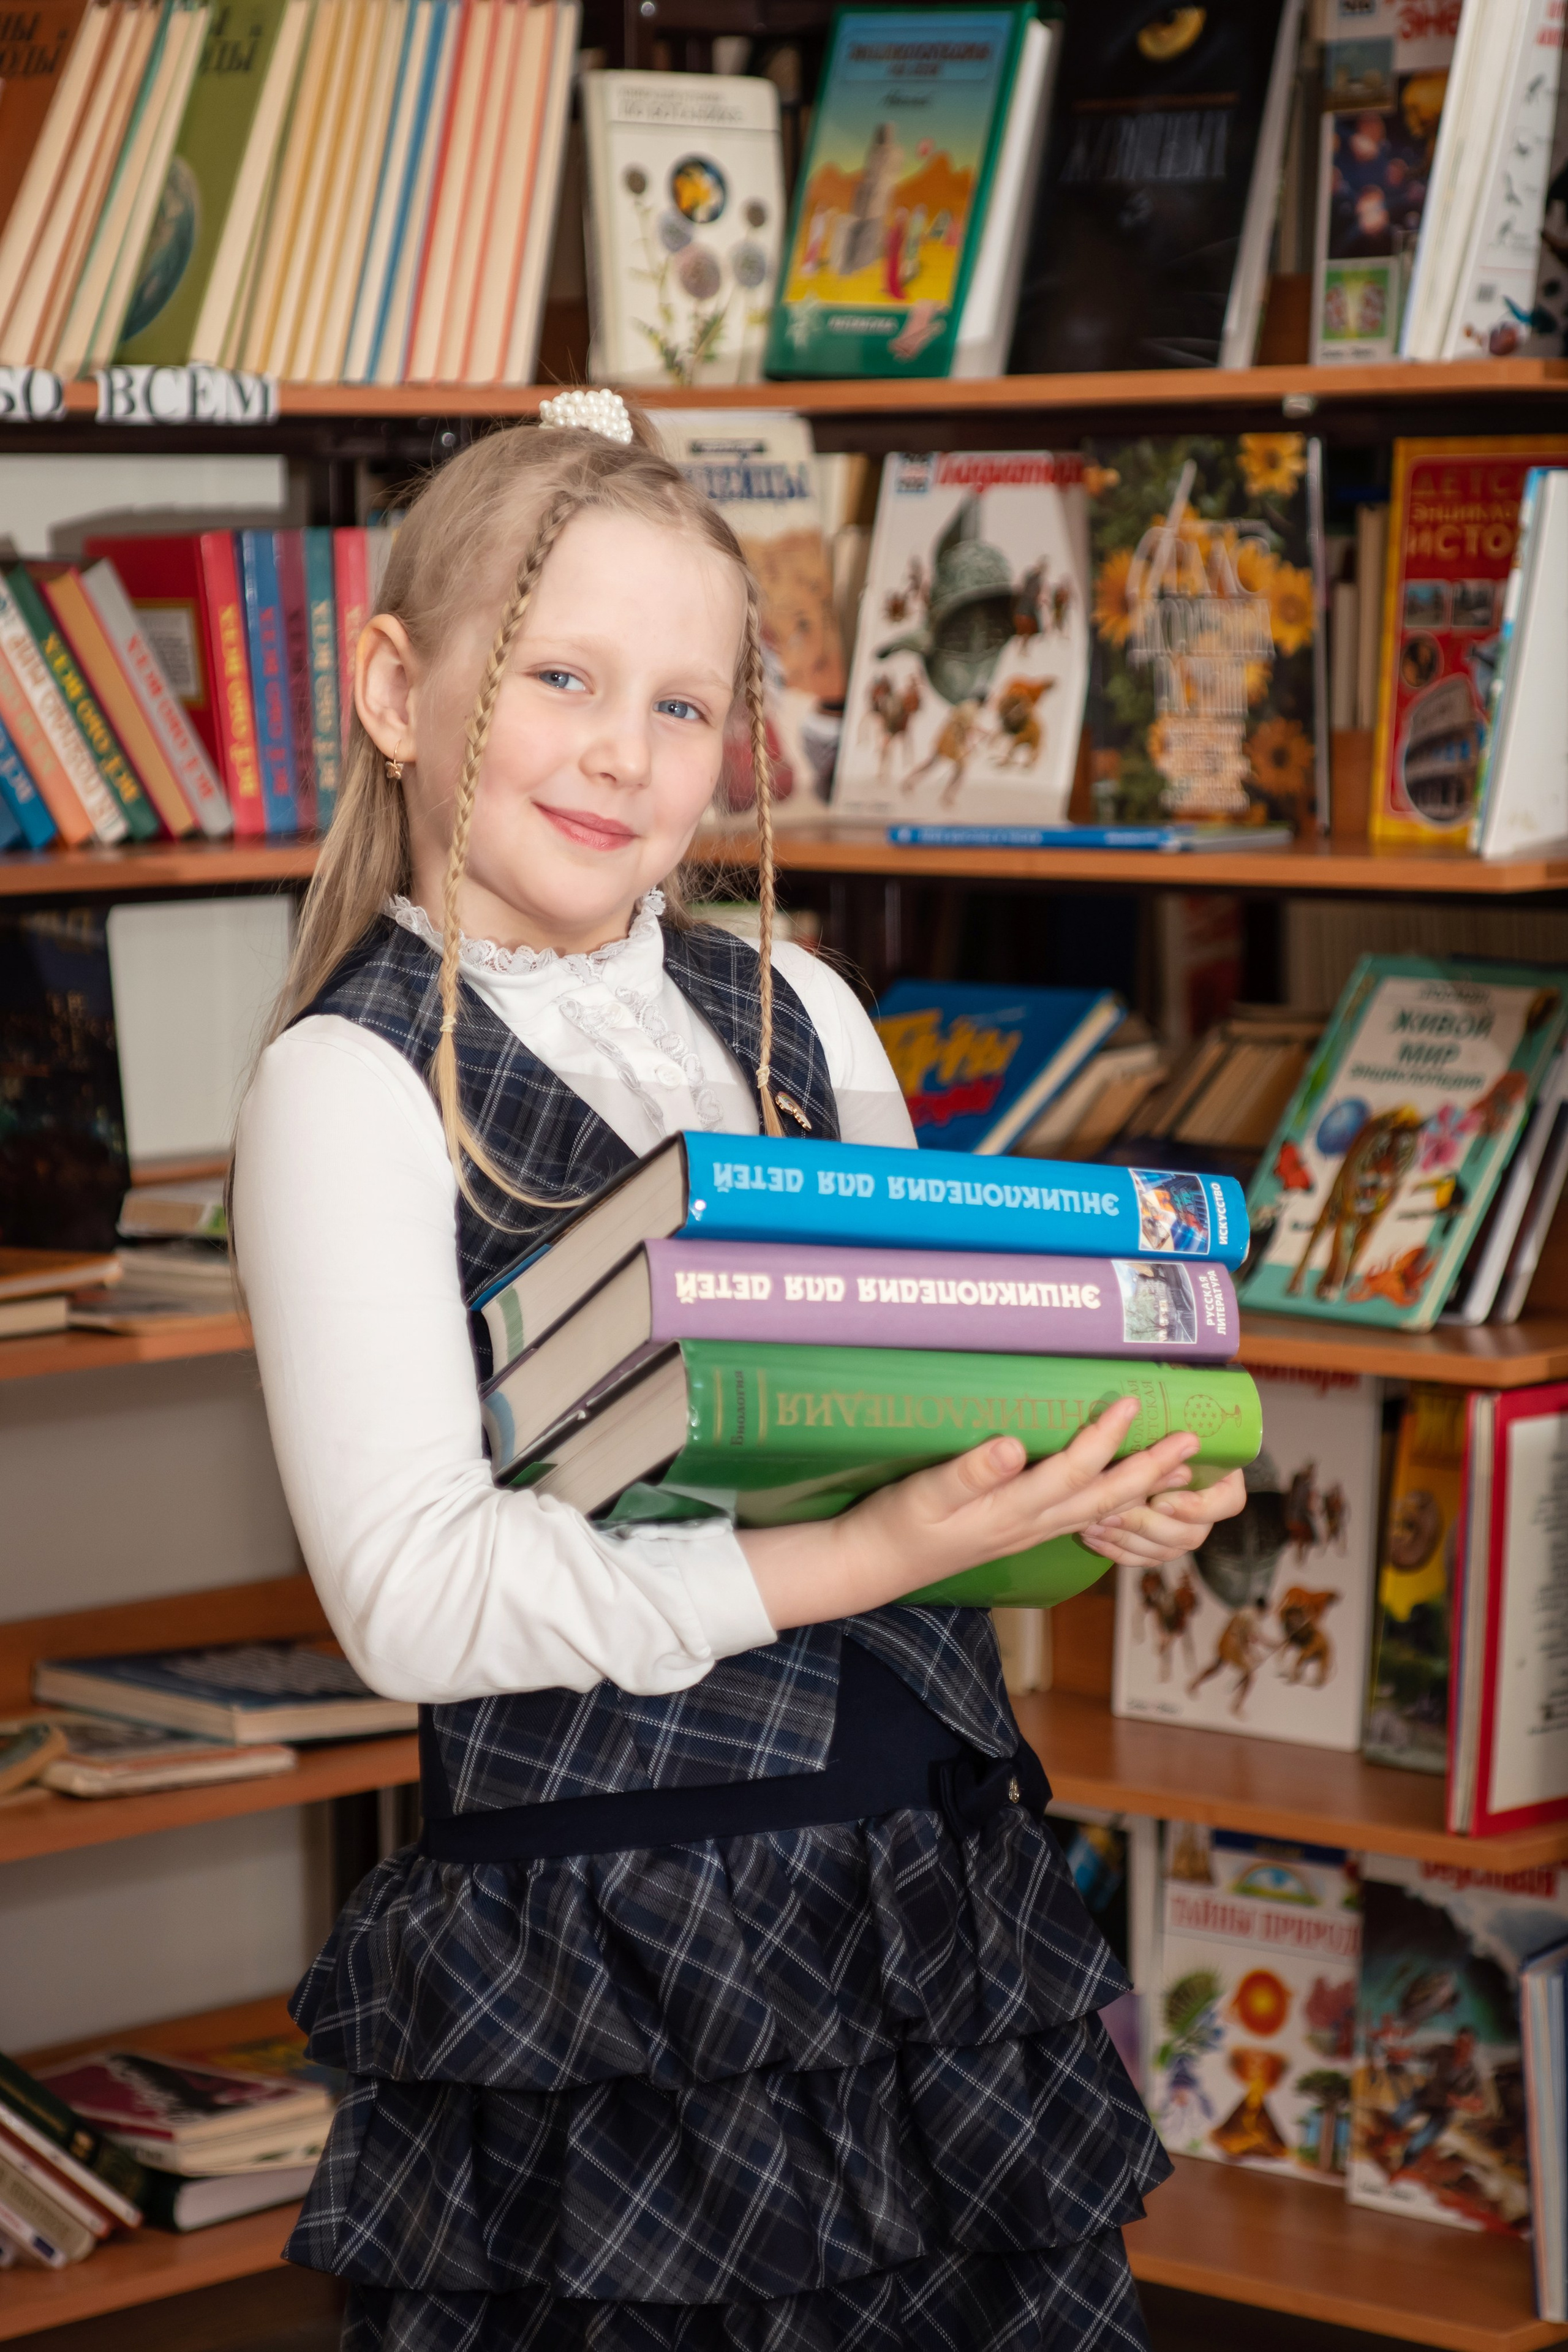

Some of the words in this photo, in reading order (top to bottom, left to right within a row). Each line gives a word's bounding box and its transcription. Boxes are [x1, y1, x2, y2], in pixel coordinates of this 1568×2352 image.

[1389, 1008, 1496, 1038] ЖИВОЙ
[1398, 1040, 1461, 1066] МИР
[712, 1162, 804, 1193] ДЕТЕЙ
[817, 1170, 875, 1198] ДЛЯ
[888, 1176, 1120, 1216] ЭНЦИКЛОПЕДИЯ
[1211, 1182, 1228, 1246] ИСКУССТВО
[674, 1272, 771, 1304] ДЕТЕЙ
[783, 1275, 845, 1302] ДЛЯ
[857, 1278, 1101, 1309] ЭНЦИКЛОПЕДИЯ
[1199, 1276, 1216, 1326] РУССКАЯ
[1207, 1270, 1226, 1335] ЛИТЕРАТУРА
[729, 1370, 745, 1446] Биология
[1127, 1381, 1144, 1452] БОЛЬАЯ
[1142, 1381, 1159, 1442] ЕТСКАЯ
